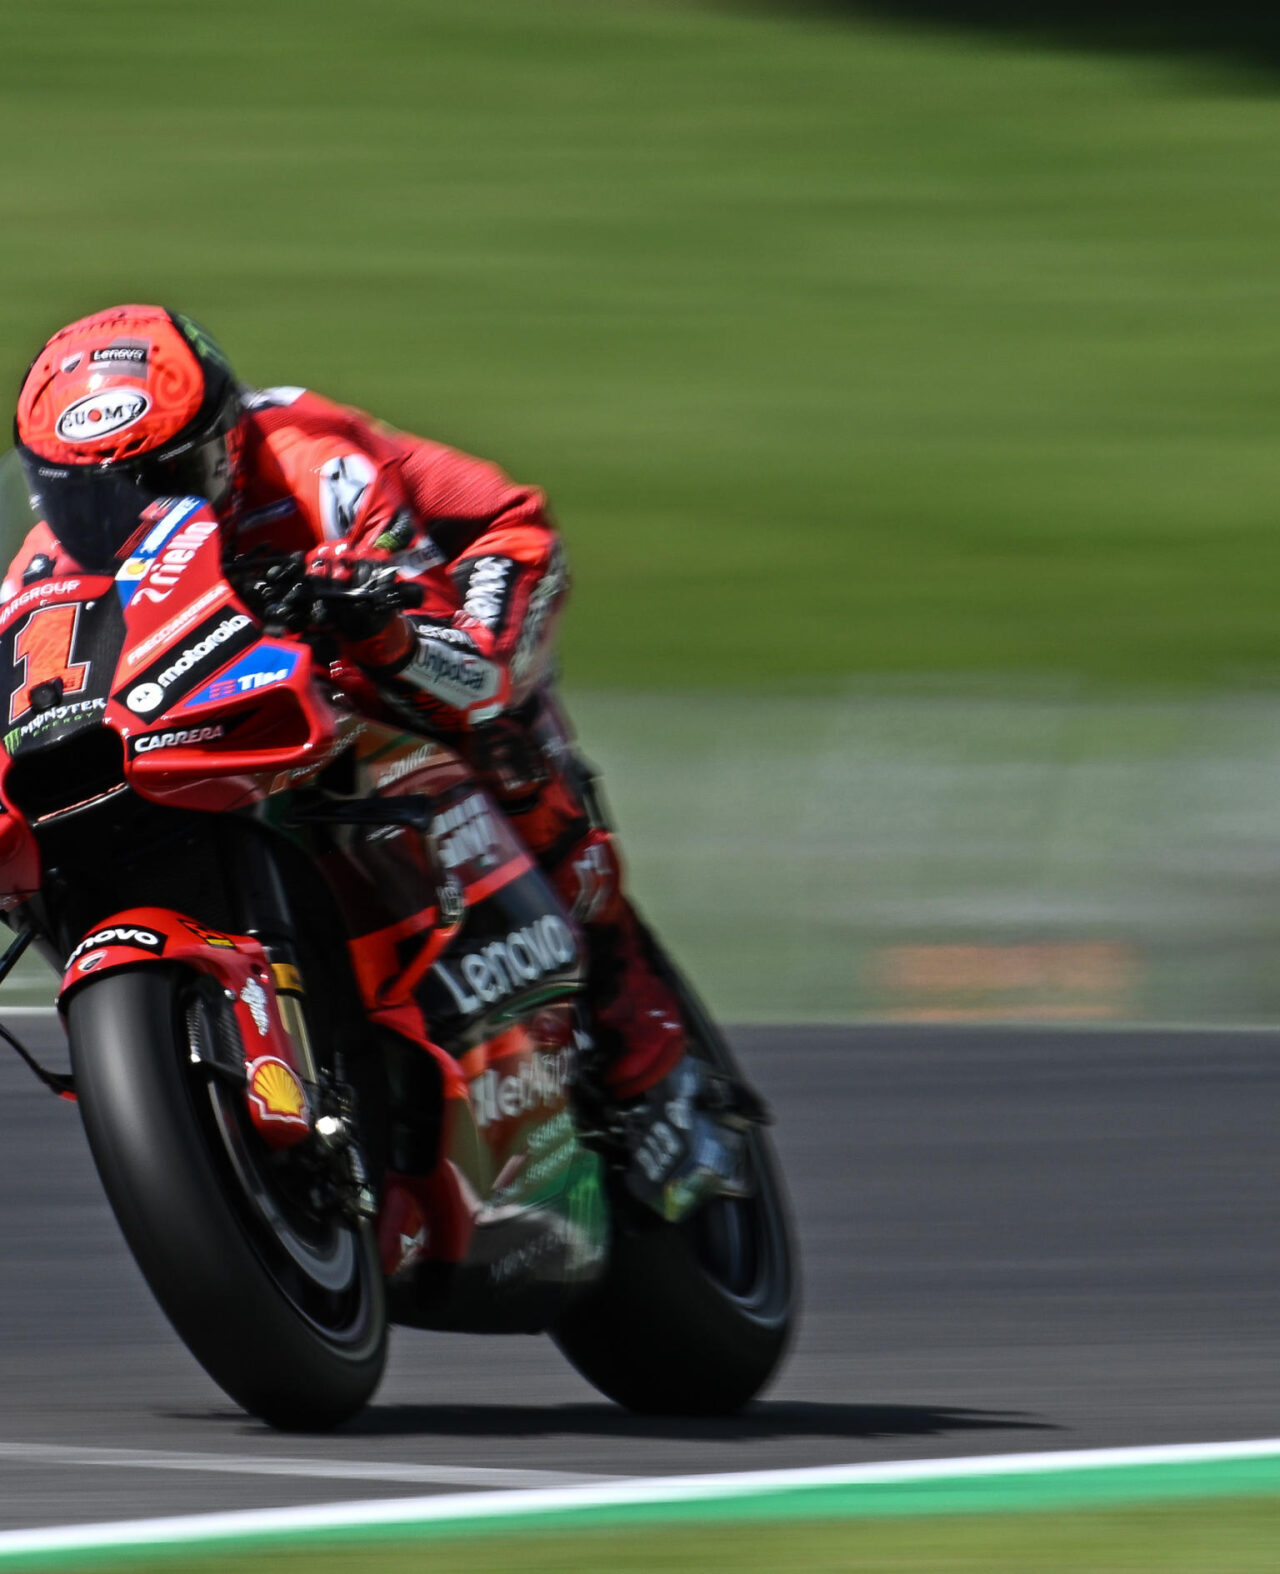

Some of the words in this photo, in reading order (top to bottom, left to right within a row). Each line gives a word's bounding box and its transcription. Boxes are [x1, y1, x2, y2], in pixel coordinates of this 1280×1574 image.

[8, 602, 91, 724] 1
[157, 614, 252, 687] motorola
[238, 668, 289, 691] TIM
[20, 698, 107, 736] MONSTER
[134, 725, 224, 753] CARRERA
[432, 914, 577, 1014] Lenovo
